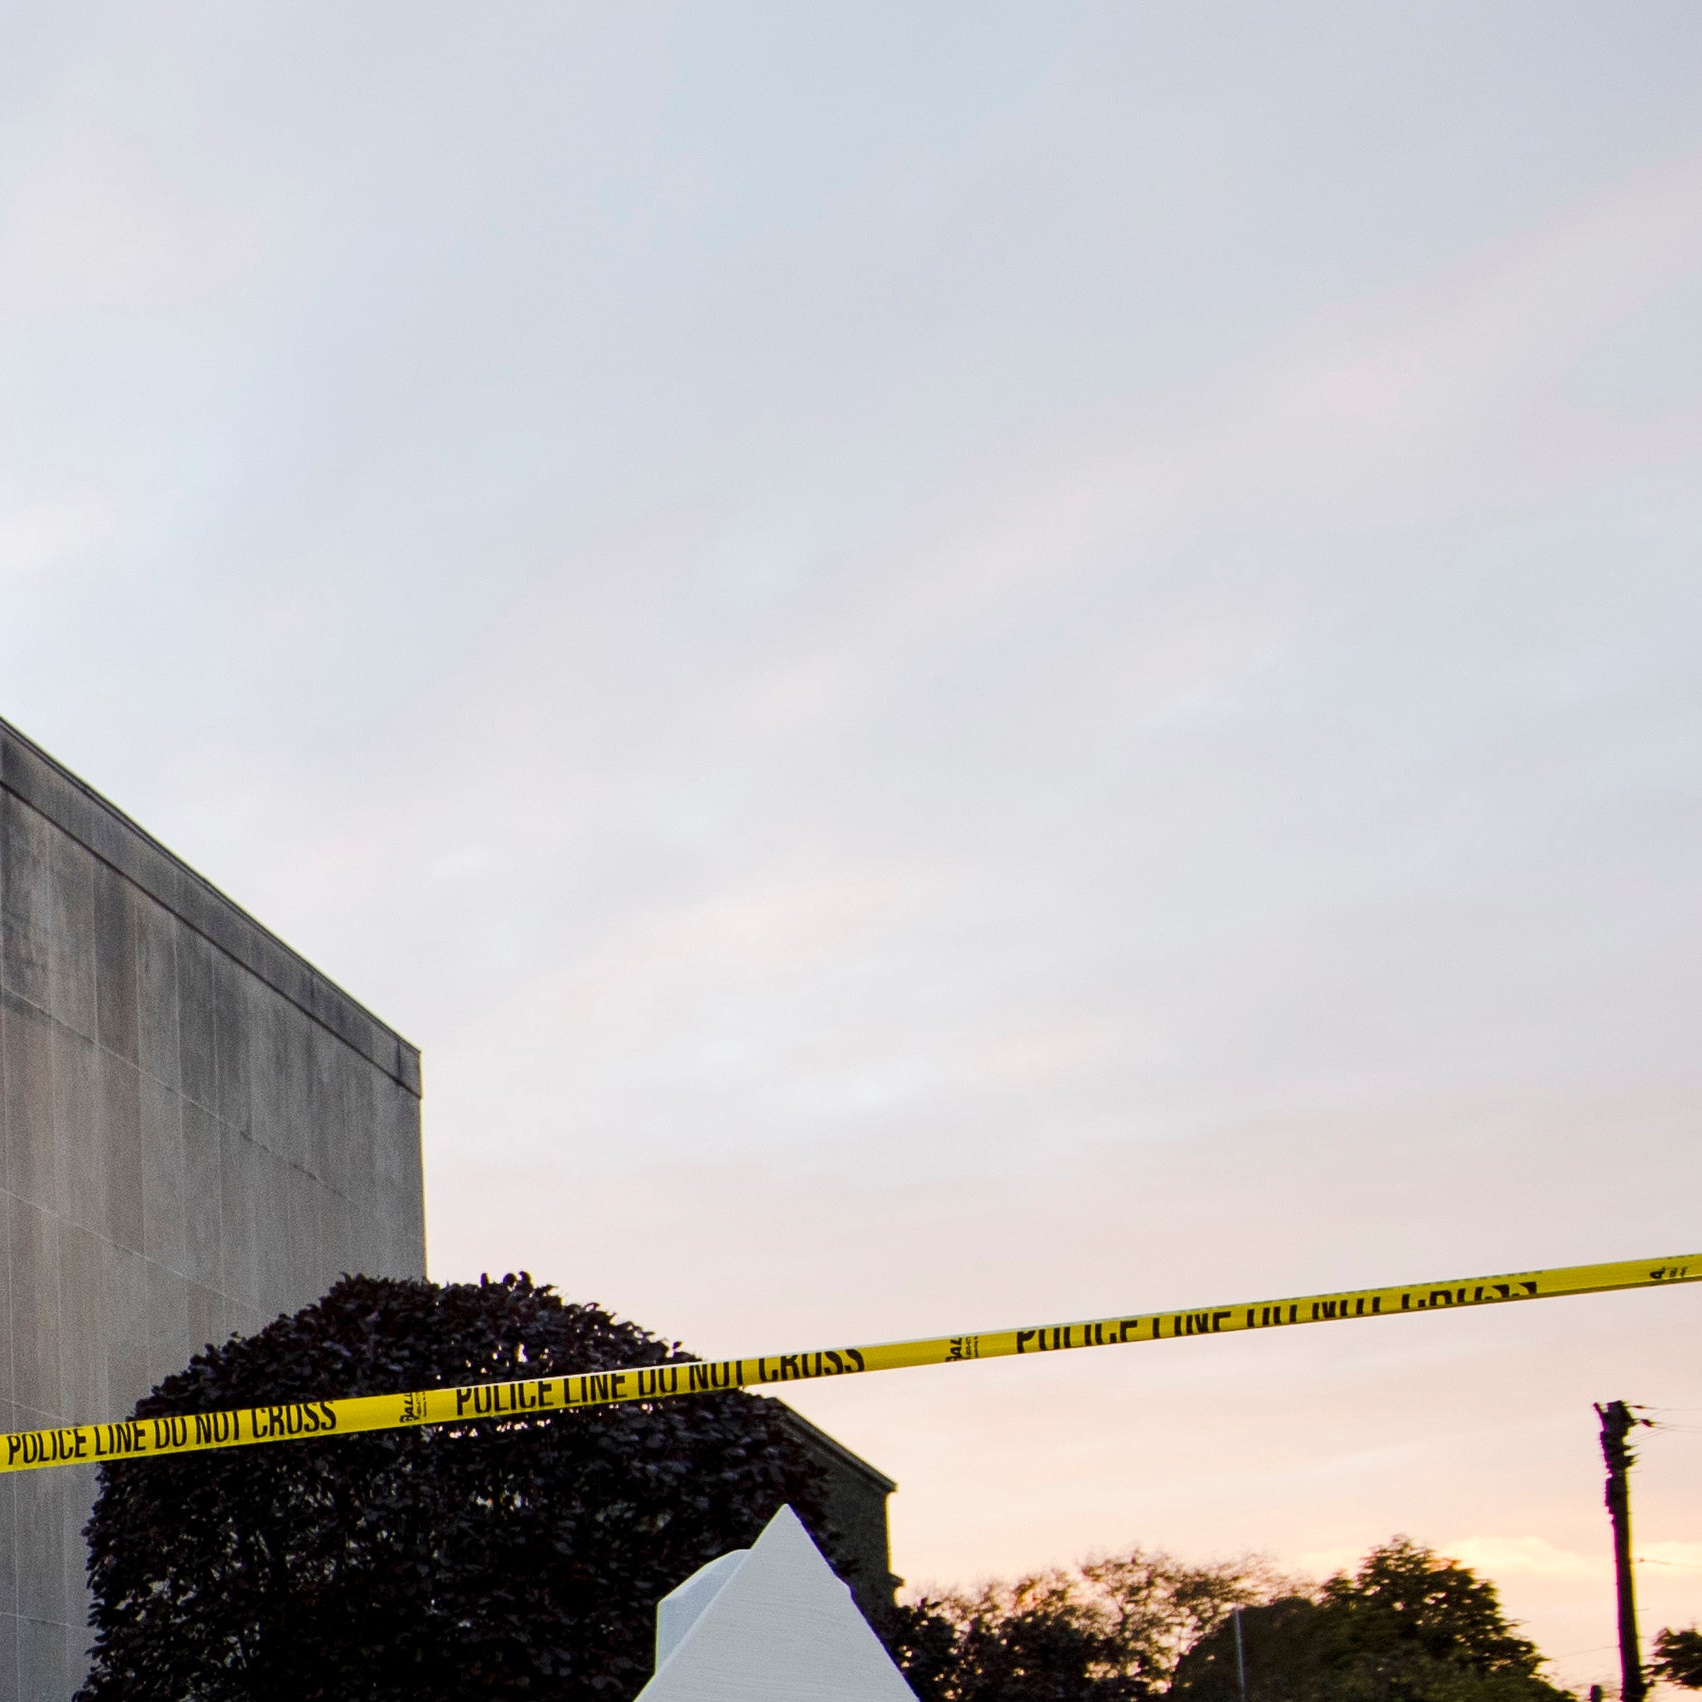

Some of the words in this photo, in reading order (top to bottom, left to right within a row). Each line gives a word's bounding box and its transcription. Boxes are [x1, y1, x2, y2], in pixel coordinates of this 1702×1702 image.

[456, 1381, 555, 1417] POLICE
[563, 1371, 628, 1406] LINE
[637, 1366, 679, 1397] DO
[688, 1359, 744, 1390] NOT
[758, 1348, 865, 1382] CROSS
[6, 1427, 88, 1466] POLICE
[94, 1419, 147, 1456] LINE
[154, 1414, 189, 1449] DO
[194, 1409, 242, 1445] NOT
[250, 1400, 338, 1438] CROSS
